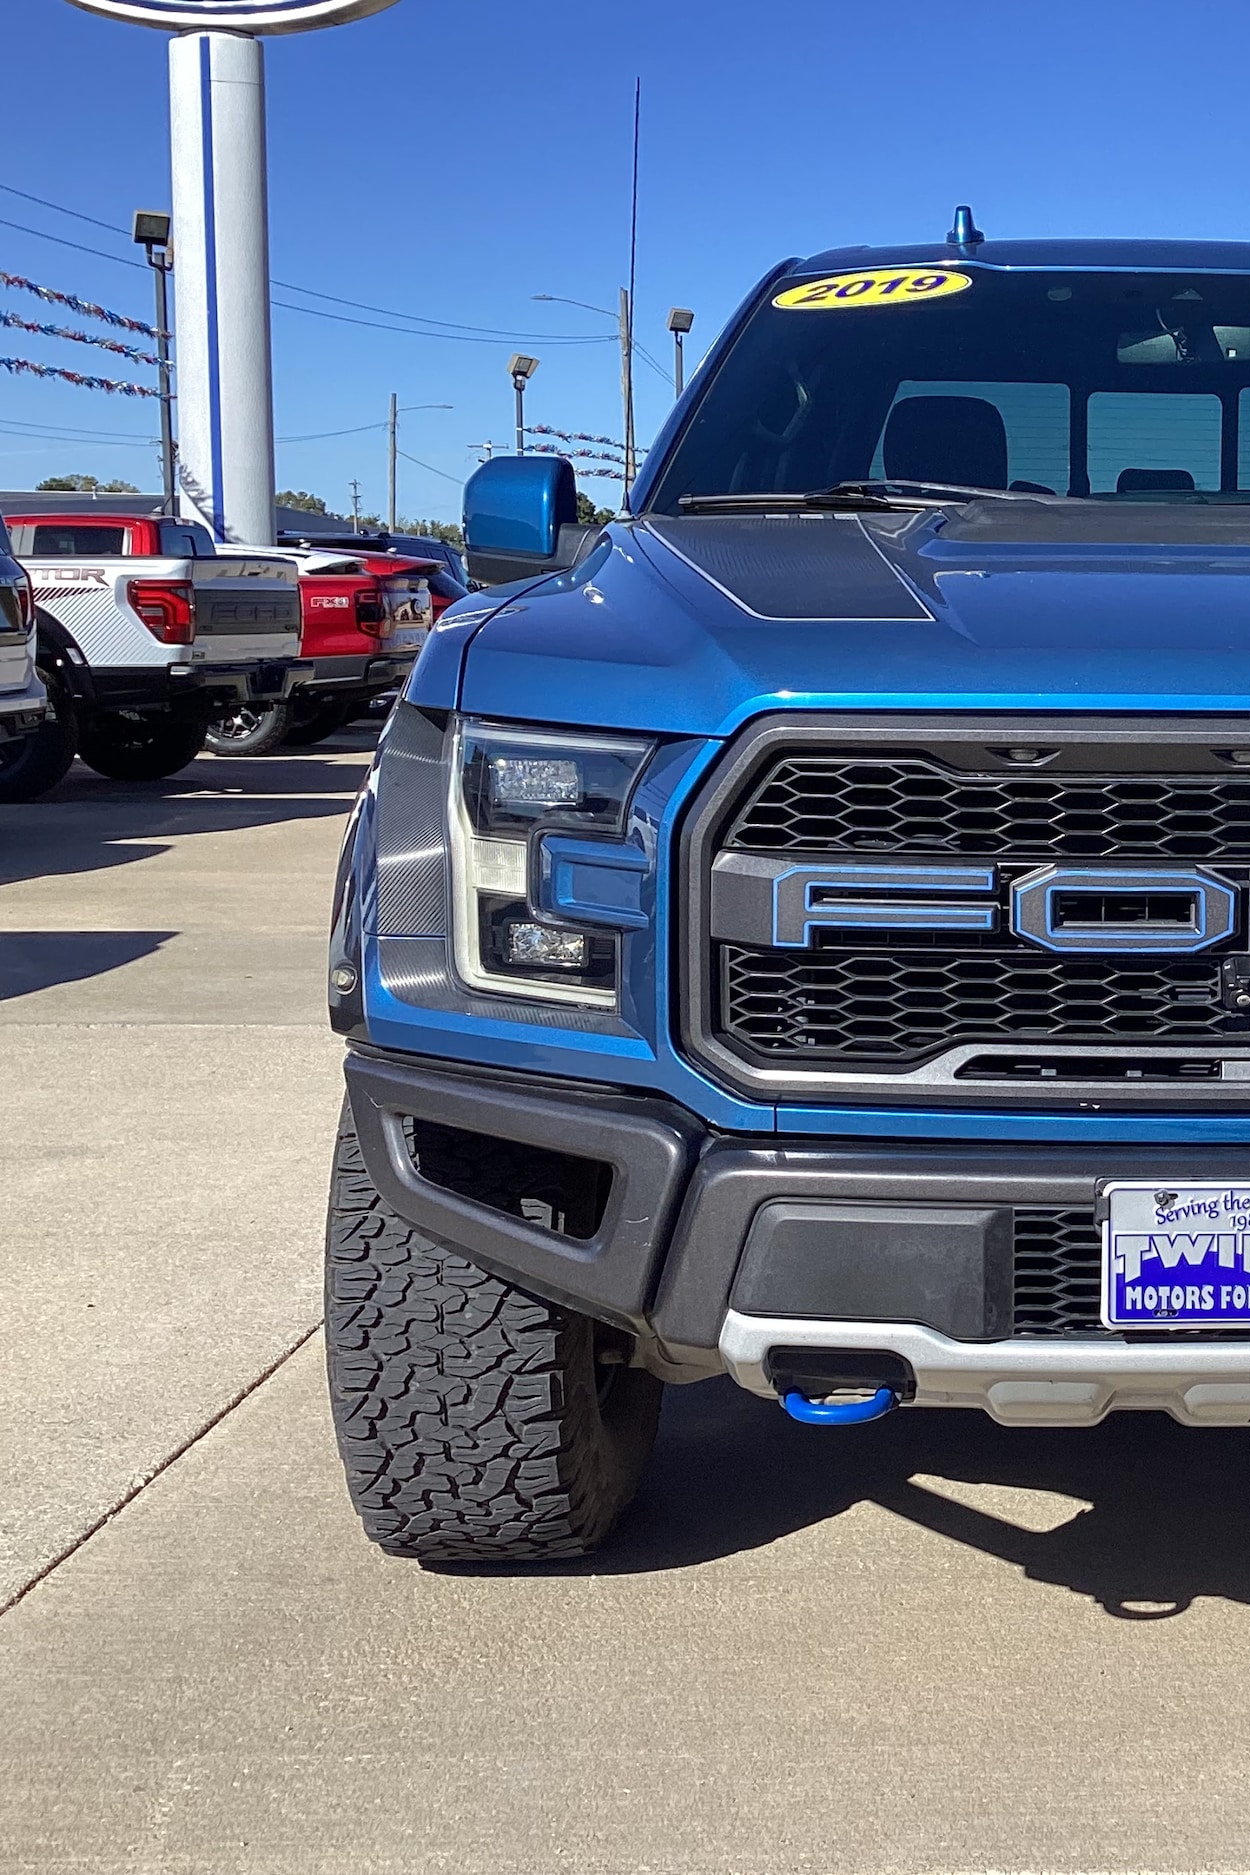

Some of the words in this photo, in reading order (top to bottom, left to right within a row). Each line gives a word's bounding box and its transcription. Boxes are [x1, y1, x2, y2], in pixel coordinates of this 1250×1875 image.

[792, 275, 948, 305] 2019
[1155, 1200, 1219, 1226] Serving
[1224, 1190, 1250, 1211] the
[1125, 1284, 1214, 1310] MOTORS
